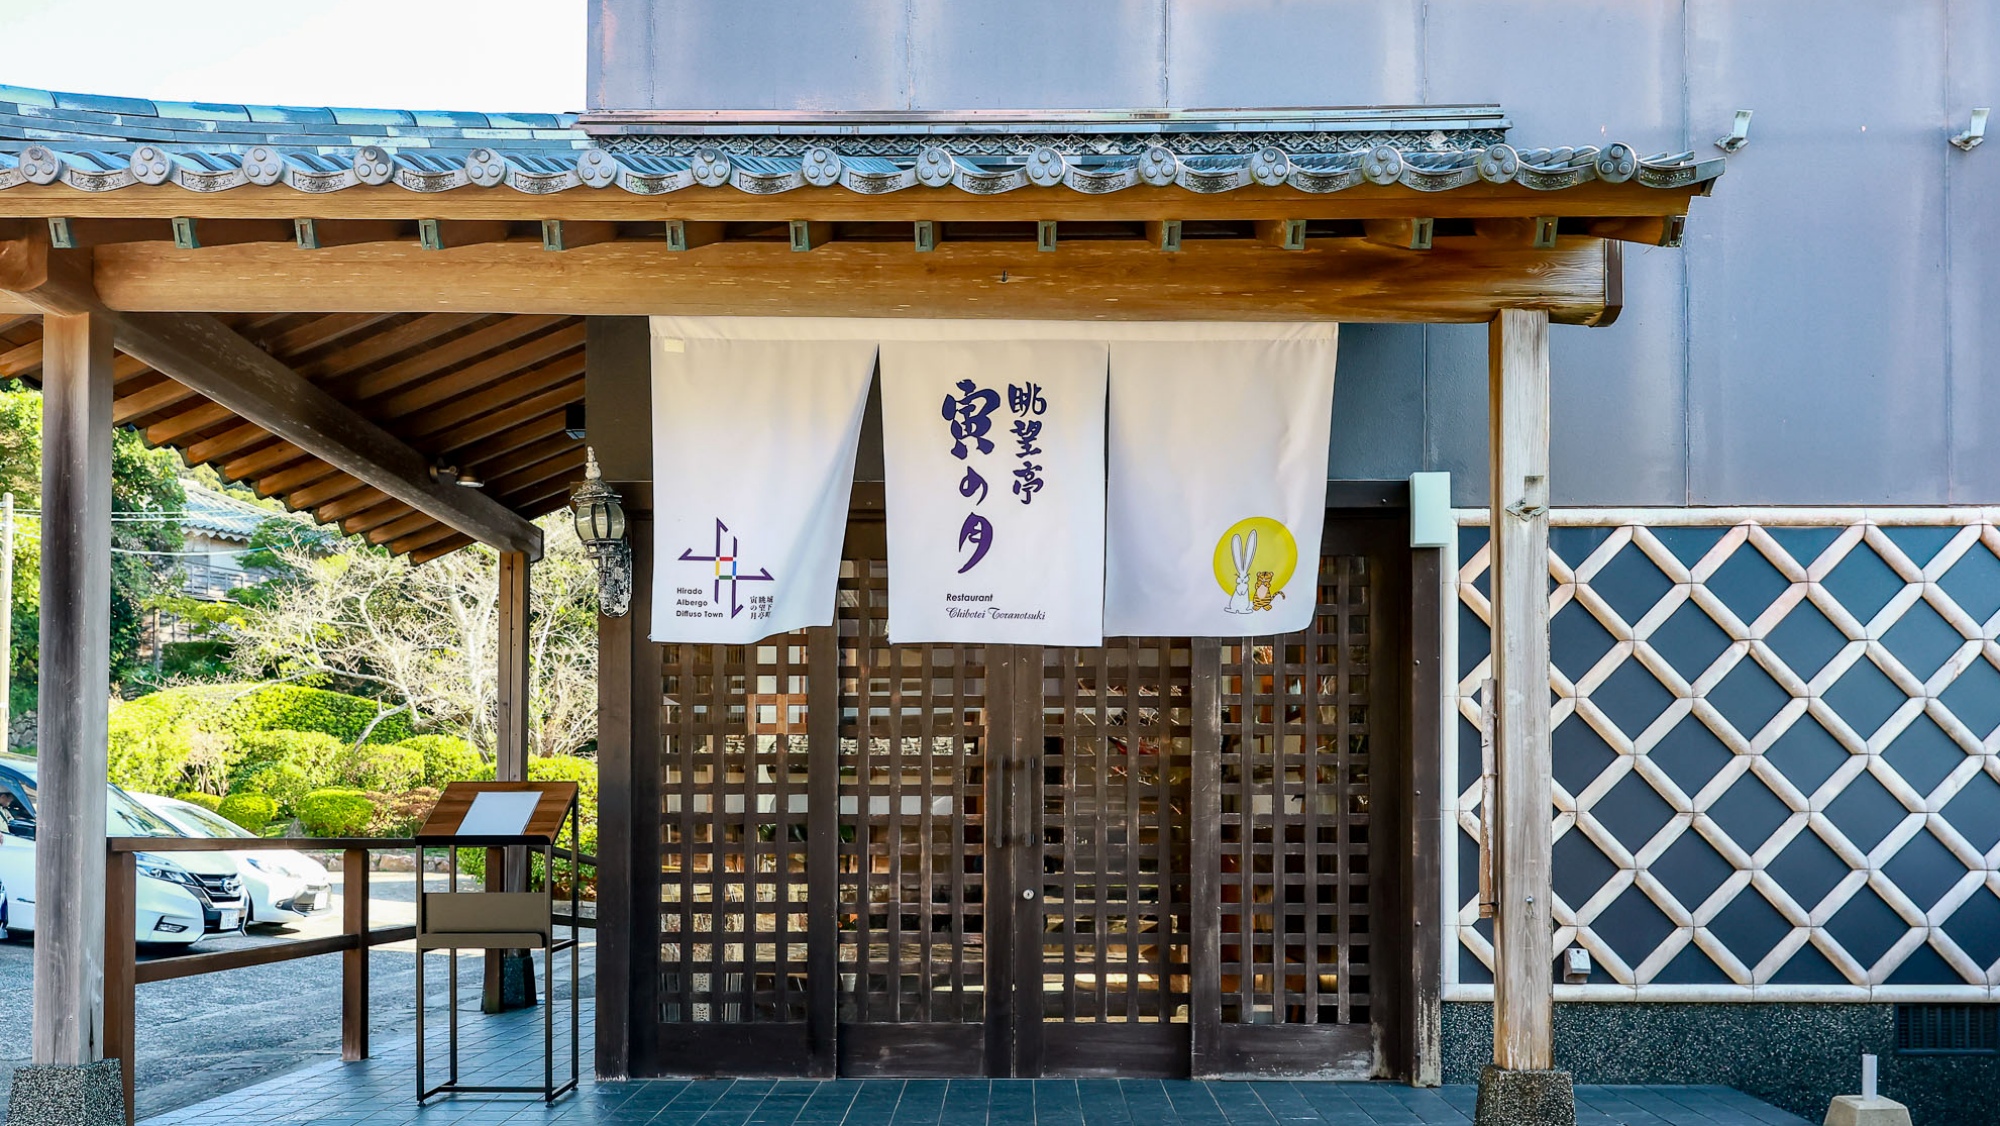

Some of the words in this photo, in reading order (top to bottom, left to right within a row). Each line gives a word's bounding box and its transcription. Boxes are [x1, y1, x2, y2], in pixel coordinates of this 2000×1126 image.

[1008, 381, 1047, 504] 眺望亭
[942, 379, 1001, 573] 寅の月
[676, 587, 702, 595] Hirado
[676, 599, 708, 607] Albergo
[946, 593, 993, 602] Restaurant
[945, 607, 986, 619] Chibotei
[987, 607, 1045, 620] Toranotsuki
